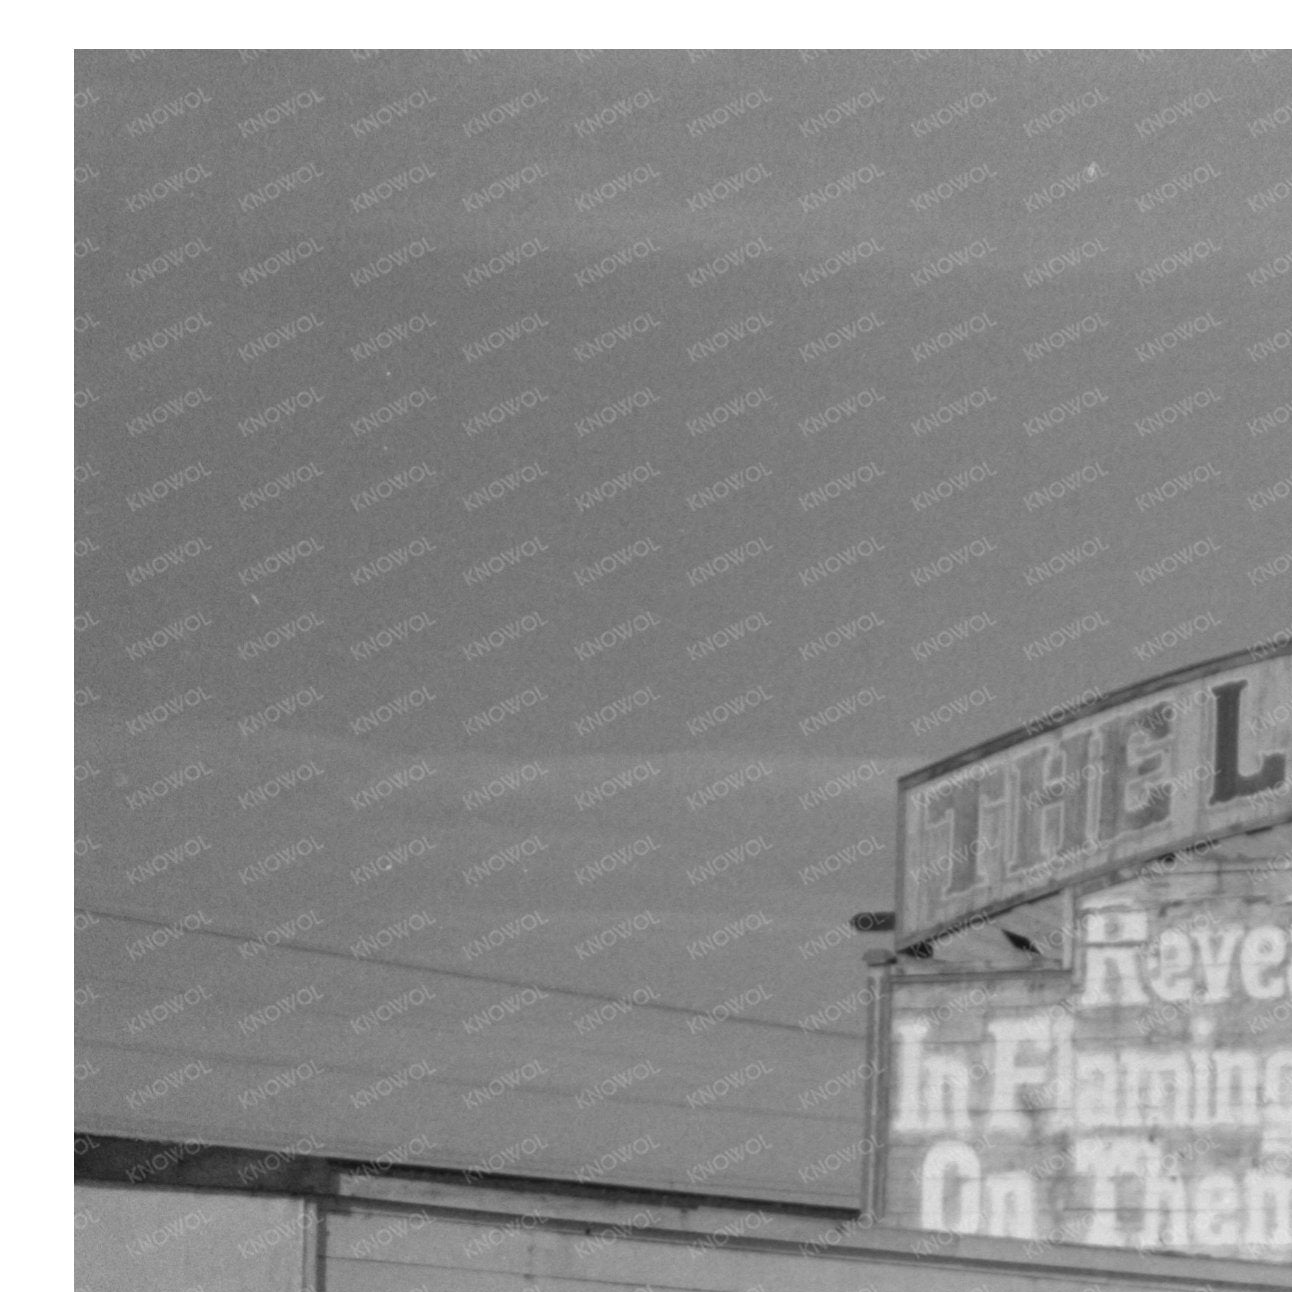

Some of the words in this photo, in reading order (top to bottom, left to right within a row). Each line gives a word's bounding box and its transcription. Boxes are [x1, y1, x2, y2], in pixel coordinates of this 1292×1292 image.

[926, 701, 1174, 897] THE
[892, 1018, 972, 1131] In
[921, 1140, 1036, 1240] On
